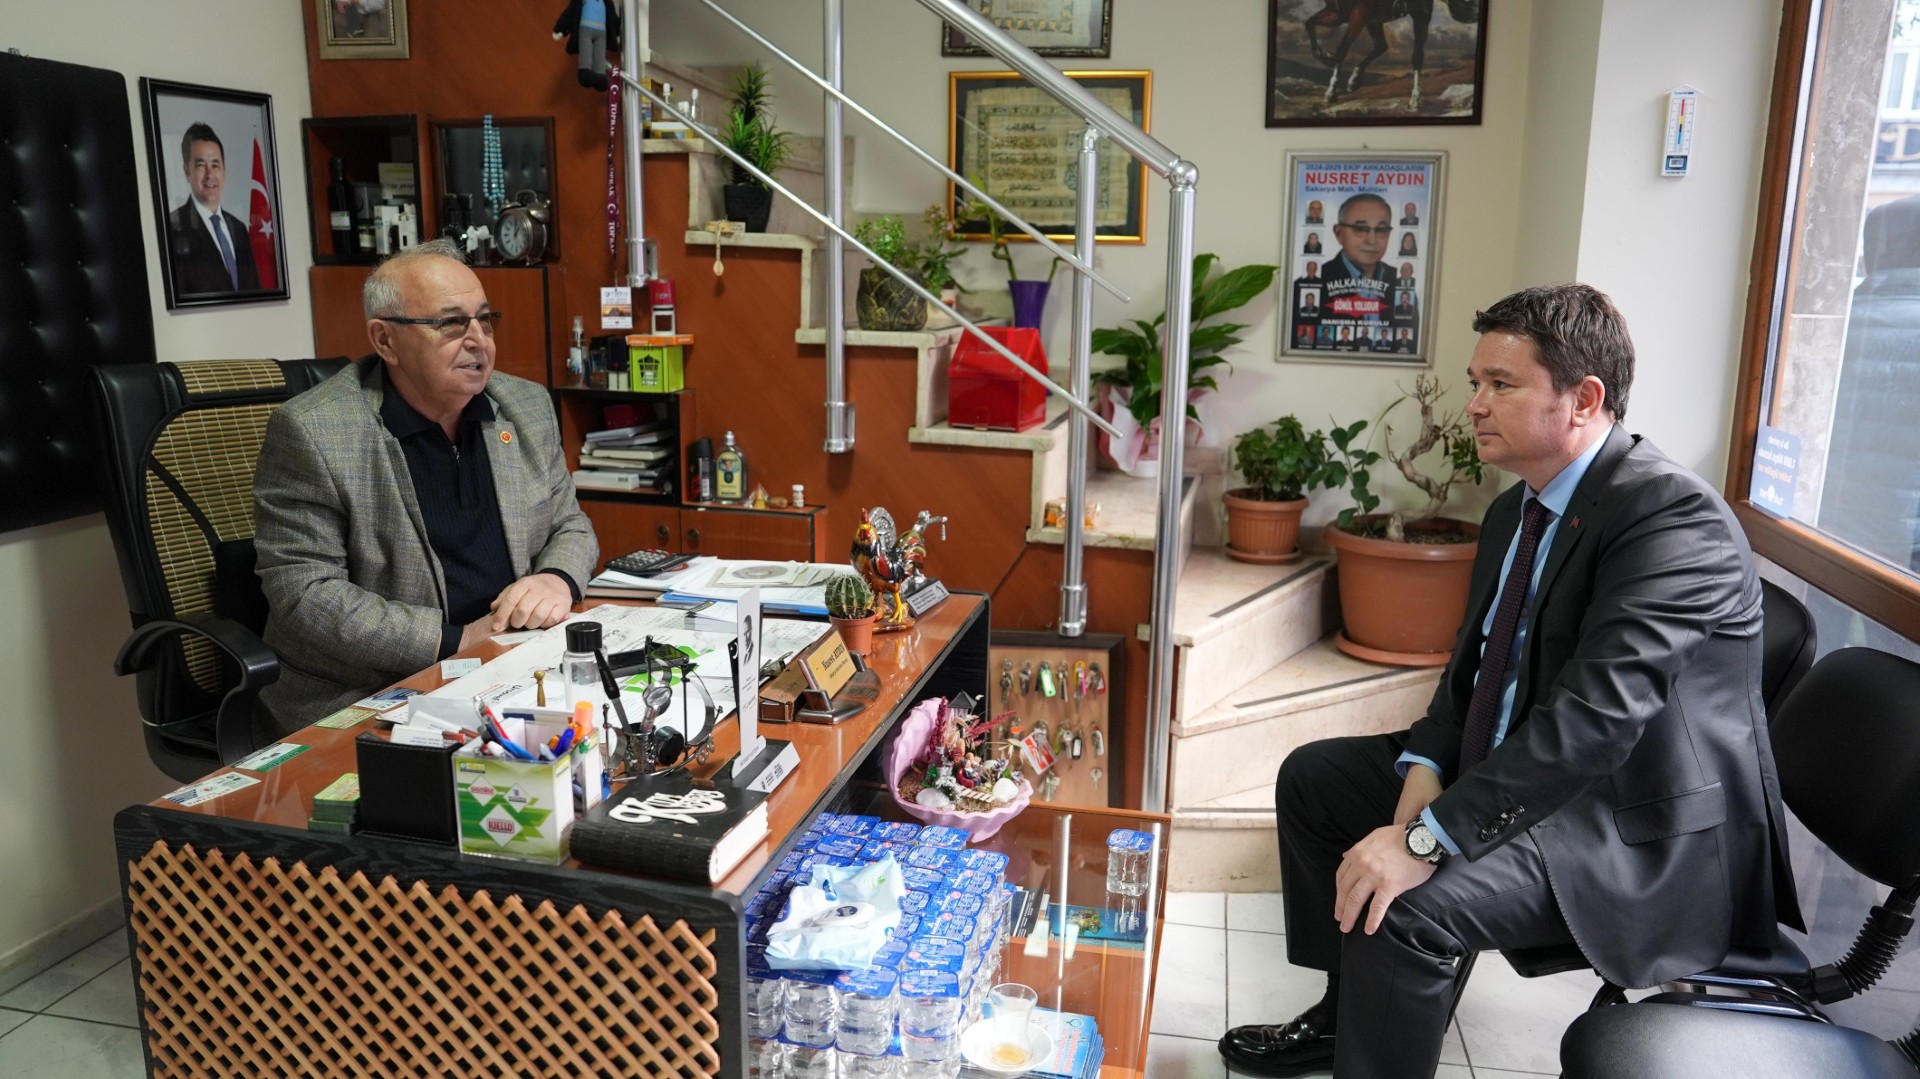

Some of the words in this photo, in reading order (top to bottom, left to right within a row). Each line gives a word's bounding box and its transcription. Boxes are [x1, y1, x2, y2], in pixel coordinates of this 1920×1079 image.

[1305, 172, 1370, 185] NUSRET
[1375, 172, 1425, 185] AYDIN
[1327, 279, 1356, 291] HALKA
[1358, 278, 1390, 291] HİZMET
[1334, 298, 1353, 311] GÖNÜL
[488, 820, 514, 832] RIELLO
